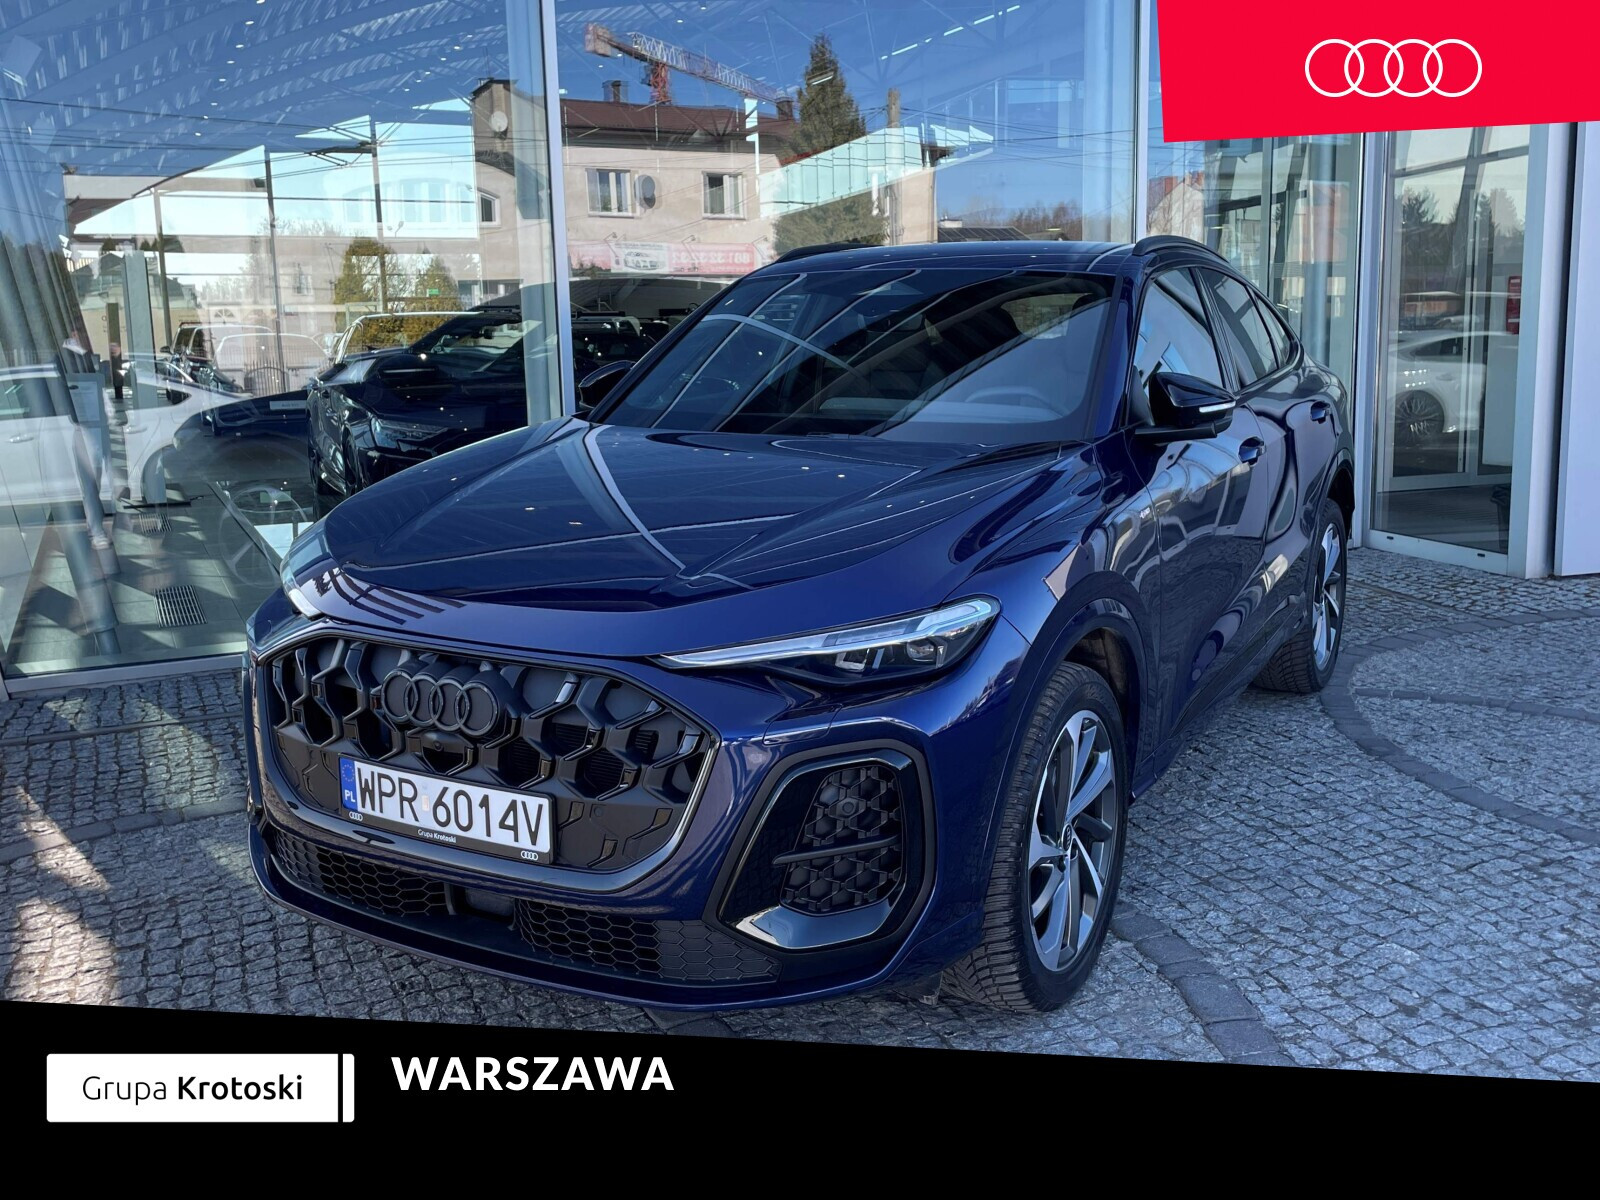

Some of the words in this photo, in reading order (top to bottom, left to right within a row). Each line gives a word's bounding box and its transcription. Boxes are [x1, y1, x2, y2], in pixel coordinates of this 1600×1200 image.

[344, 789, 356, 803] PL
[357, 767, 420, 822] WPR
[432, 786, 543, 846] 6014V
[417, 829, 434, 839] Grupa
[433, 832, 457, 843] Krotoski
